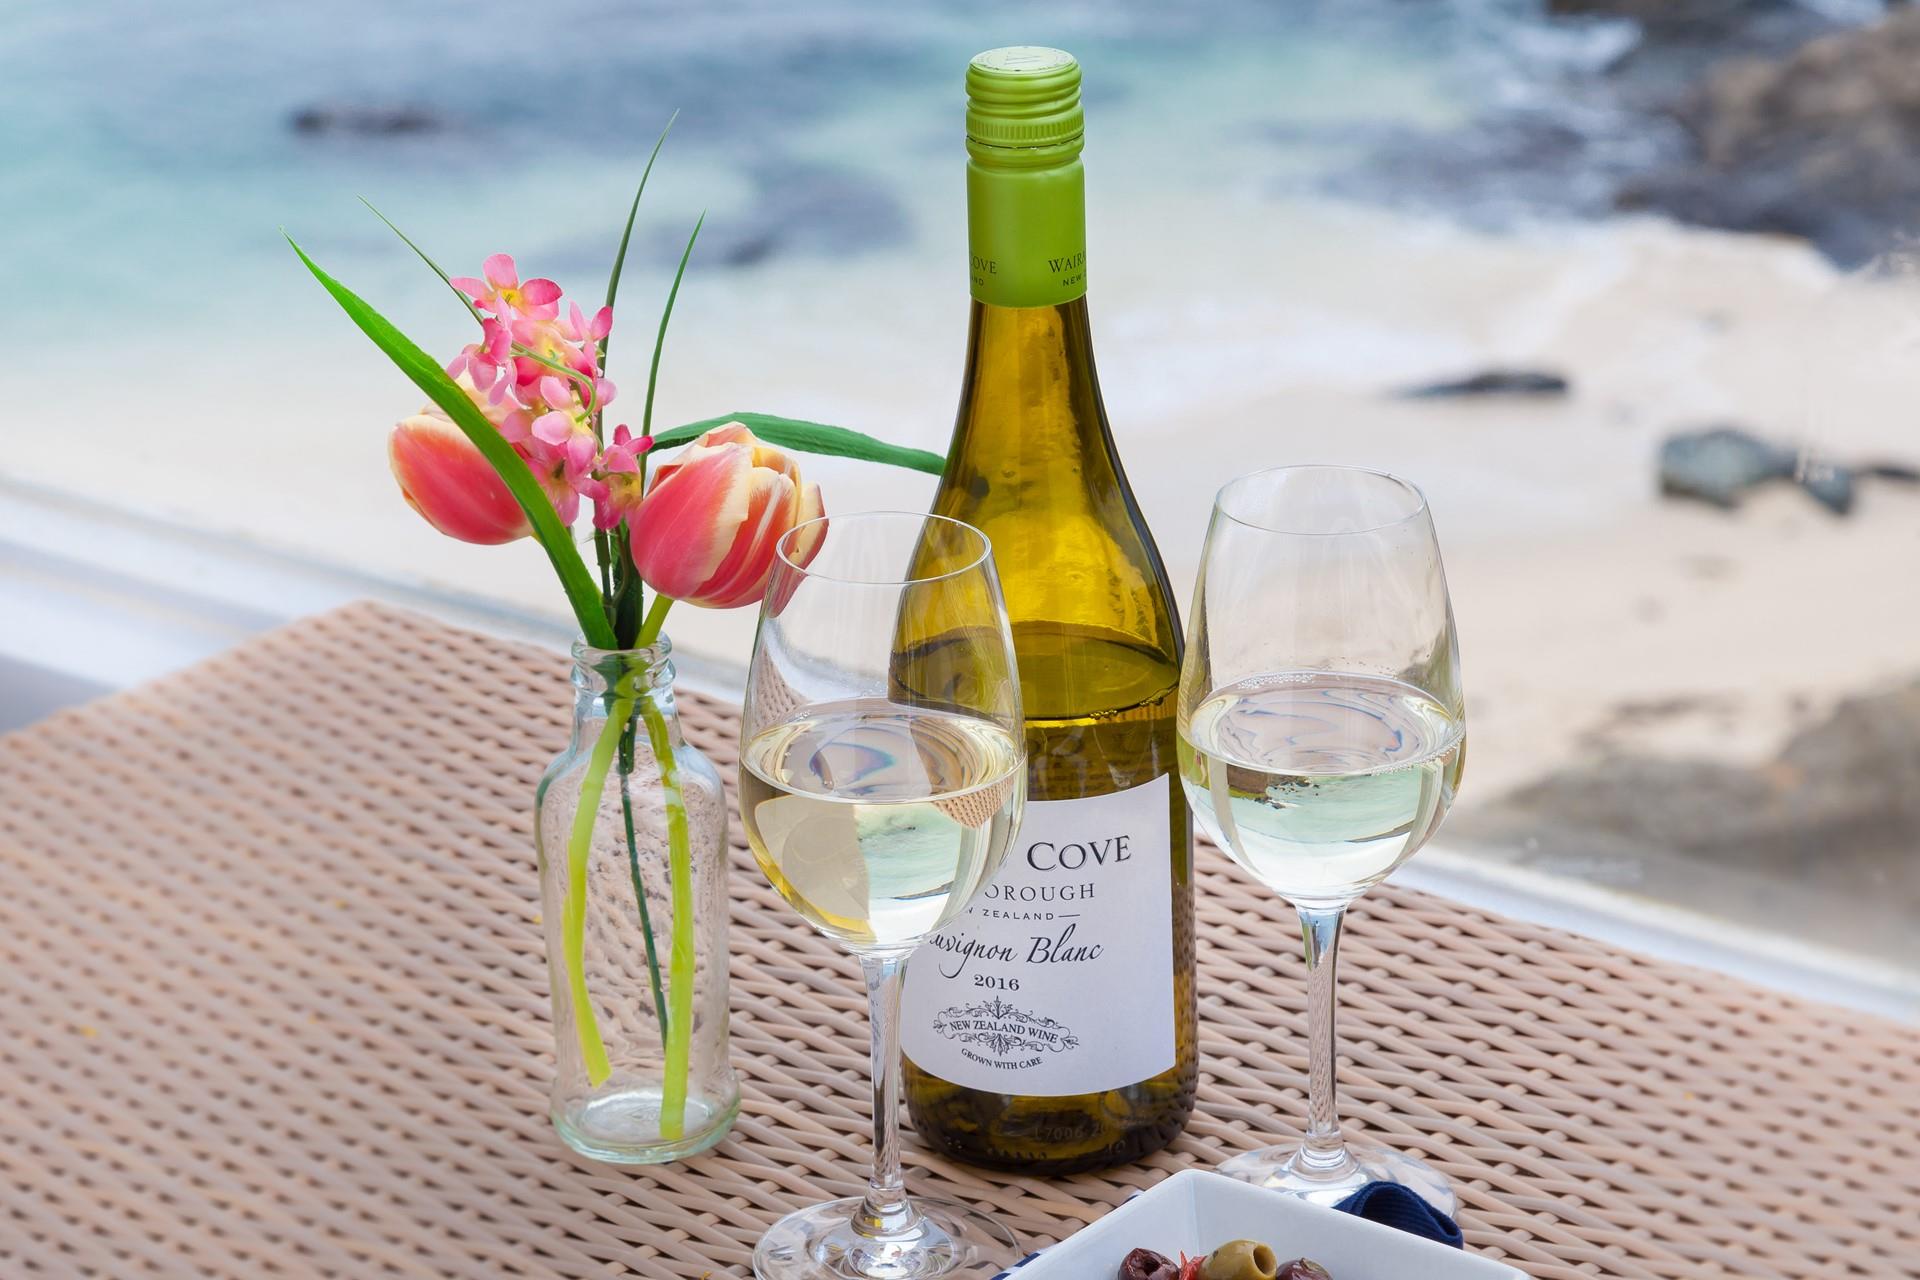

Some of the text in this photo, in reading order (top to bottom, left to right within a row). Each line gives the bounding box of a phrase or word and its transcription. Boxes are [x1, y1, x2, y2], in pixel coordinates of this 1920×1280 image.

[1062, 273, 1082, 287] NEW
[1026, 834, 1133, 872] COVE
[984, 882, 1095, 902] OROUGH
[982, 908, 1054, 920] ZEALAND
[929, 922, 1104, 979] uvignon Blanc
[974, 973, 1020, 991] 2016
[949, 1020, 1058, 1043] NEW ZEALAND WINE
[961, 1048, 1044, 1070] GROWN WITH CARE
